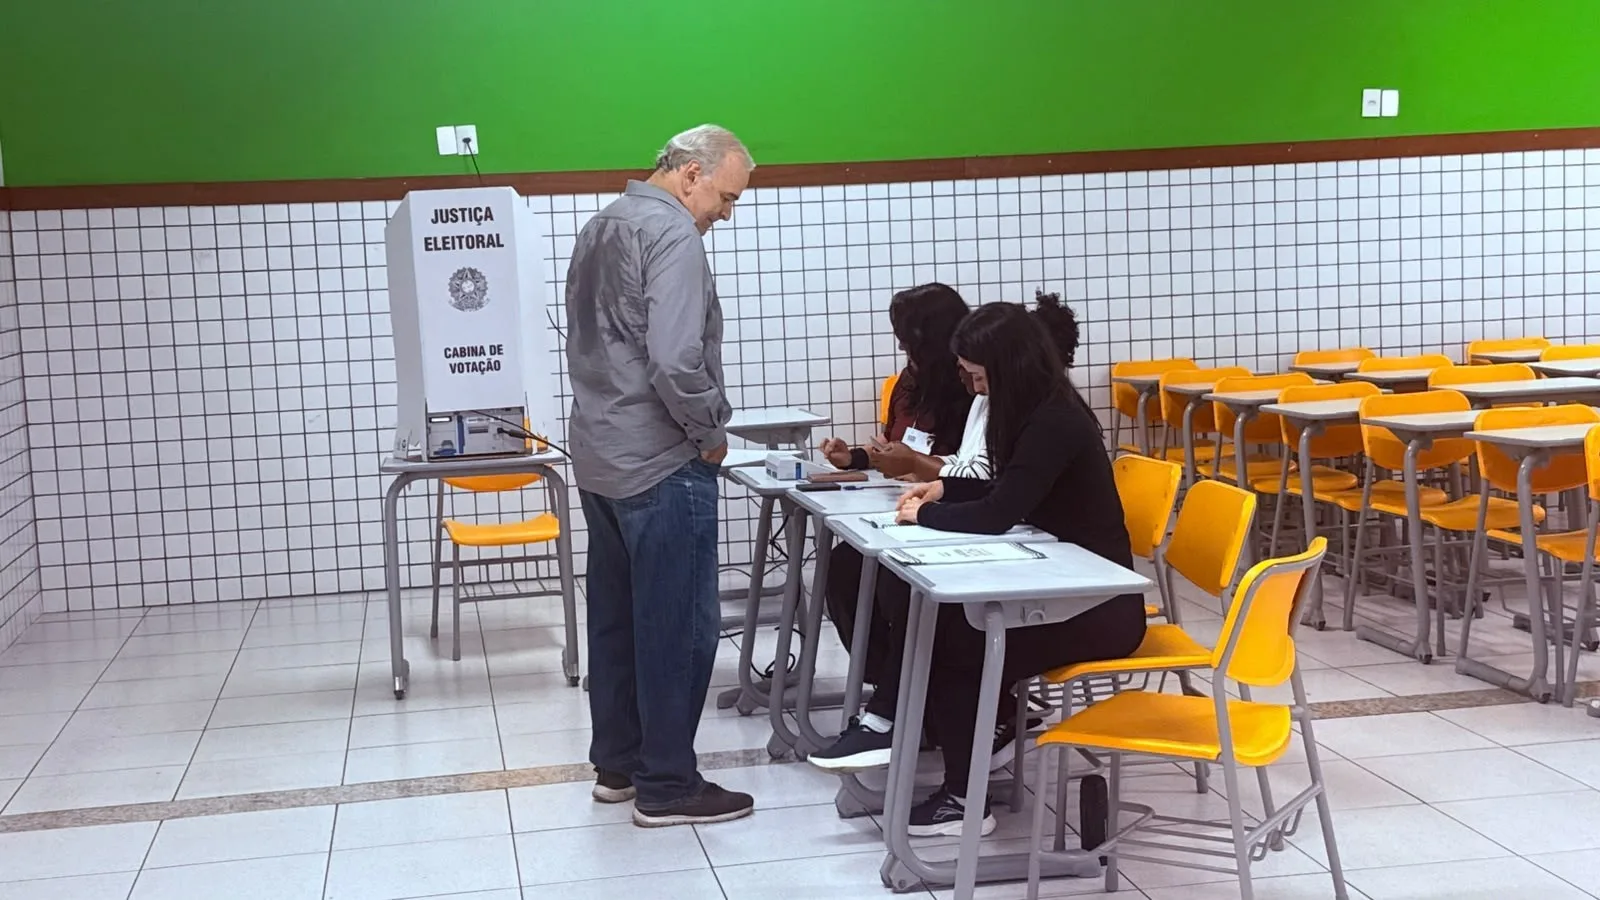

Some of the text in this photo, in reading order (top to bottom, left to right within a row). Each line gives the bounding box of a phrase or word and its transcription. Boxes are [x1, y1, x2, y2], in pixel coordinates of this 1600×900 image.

[430, 206, 494, 227] JUSTIÇA
[424, 233, 505, 252] ELEITORAL
[444, 344, 504, 359] CABINA DE
[449, 358, 501, 375] VOTAÇÃO
